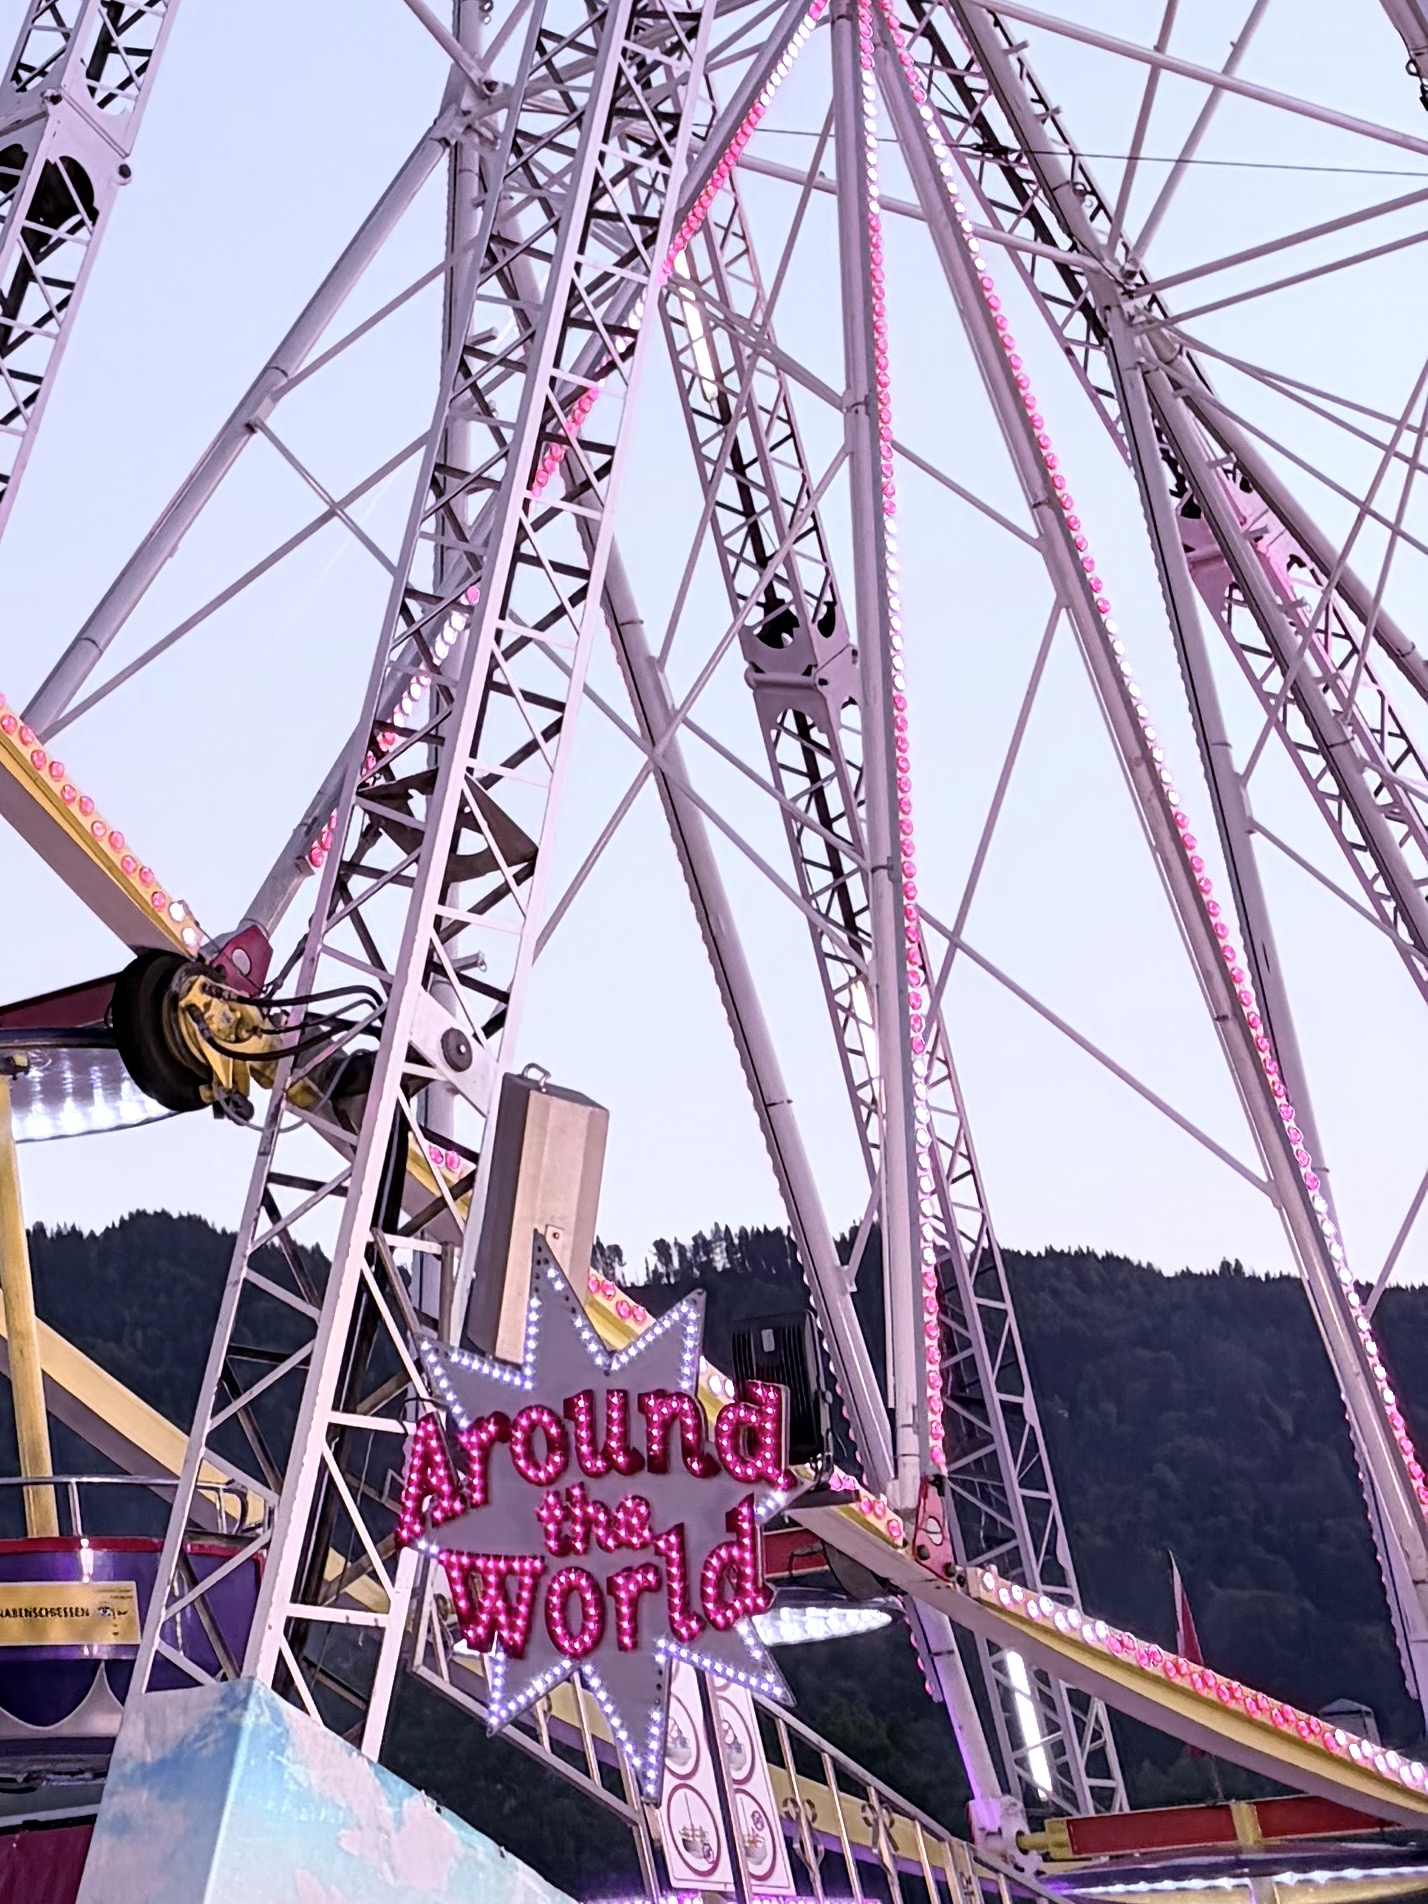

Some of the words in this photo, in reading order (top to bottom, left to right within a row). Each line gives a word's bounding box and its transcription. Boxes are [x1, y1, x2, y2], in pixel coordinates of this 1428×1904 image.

[395, 1379, 797, 1548] Around
[537, 1481, 654, 1557] the
[436, 1492, 776, 1662] World
